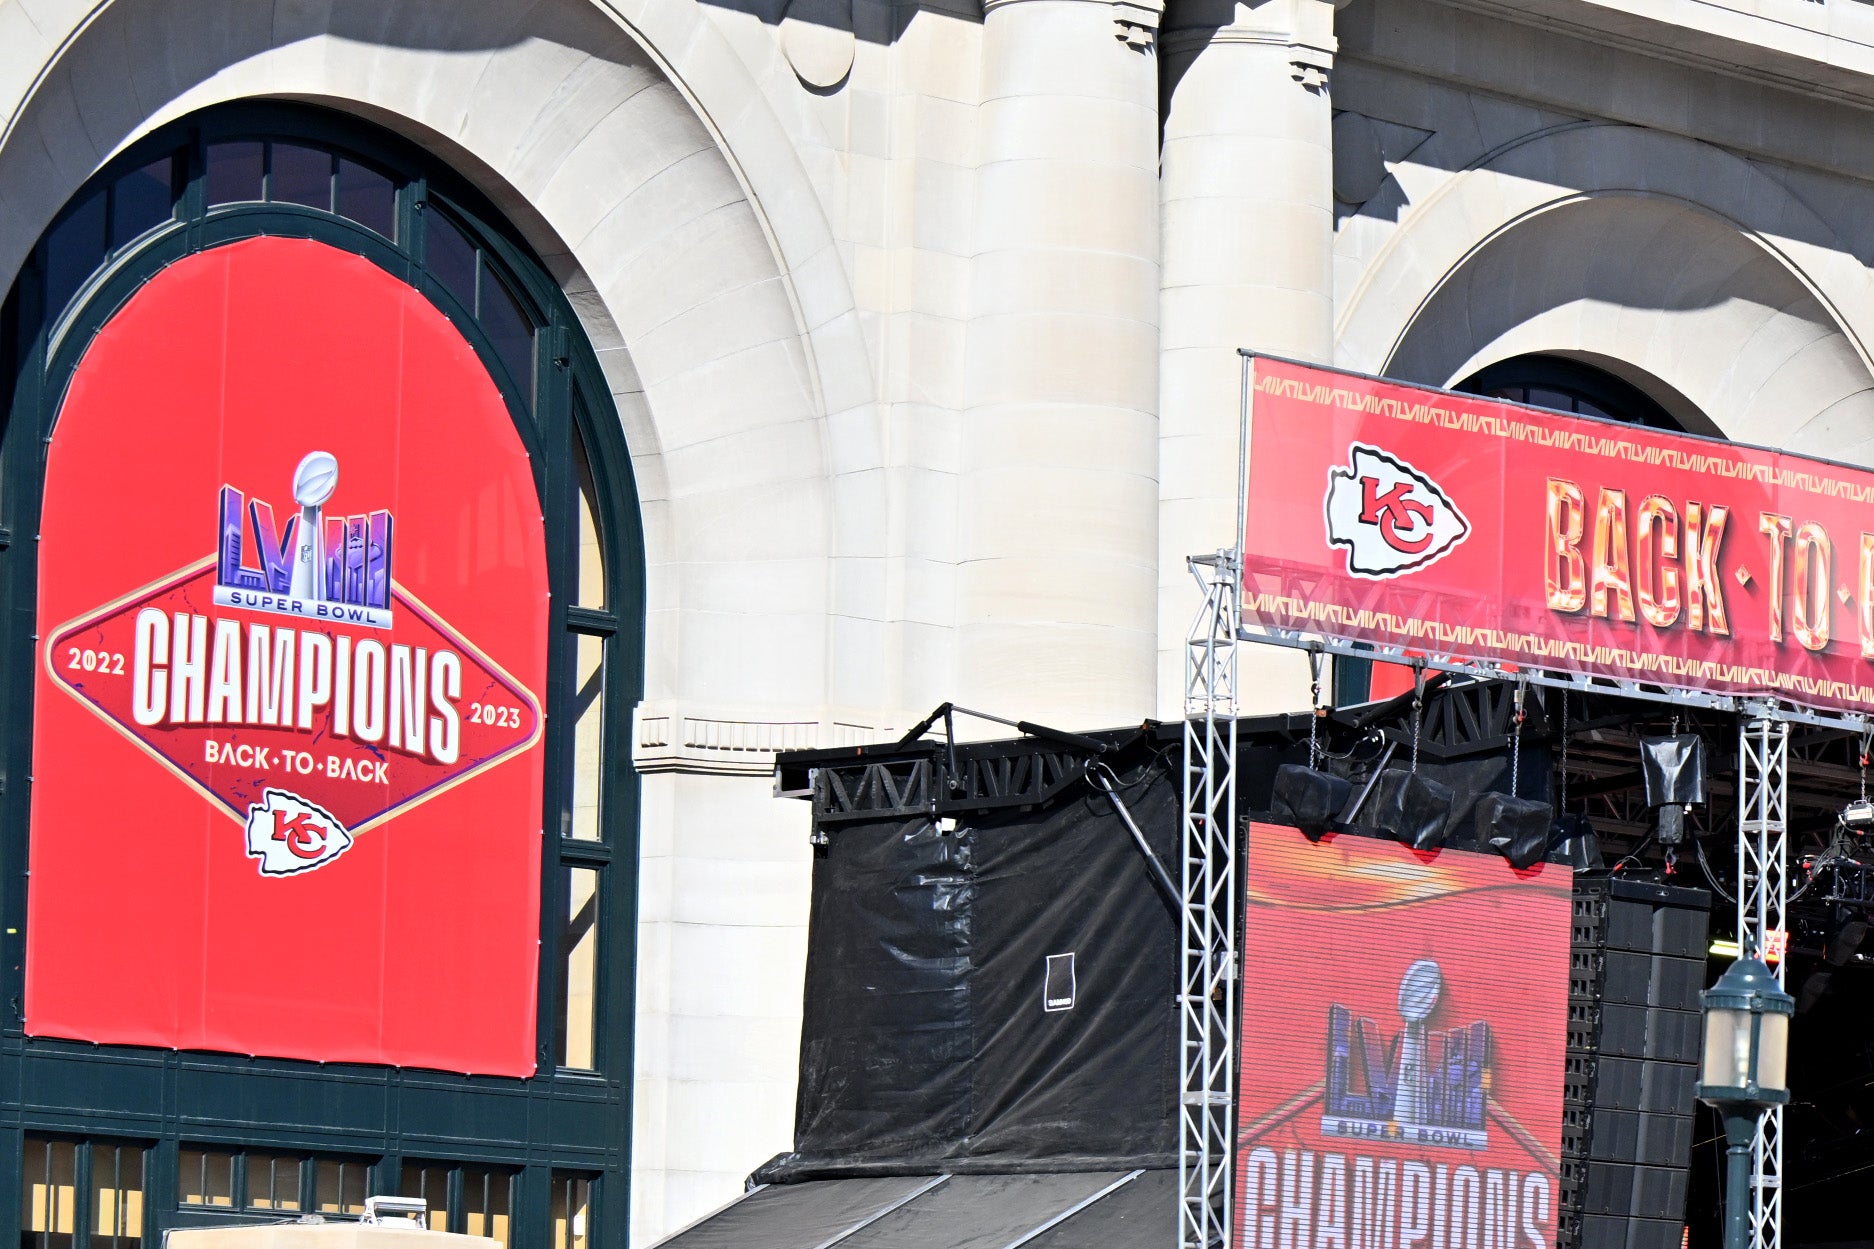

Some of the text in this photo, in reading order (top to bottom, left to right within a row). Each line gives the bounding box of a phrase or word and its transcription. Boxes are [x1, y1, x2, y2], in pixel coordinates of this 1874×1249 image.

[231, 592, 376, 624] SUPER BOWL
[67, 648, 125, 675] 2022
[132, 607, 461, 765] CHAMPIONS
[470, 702, 521, 729] 2023
[1337, 1121, 1473, 1148] SUPER BOWL
